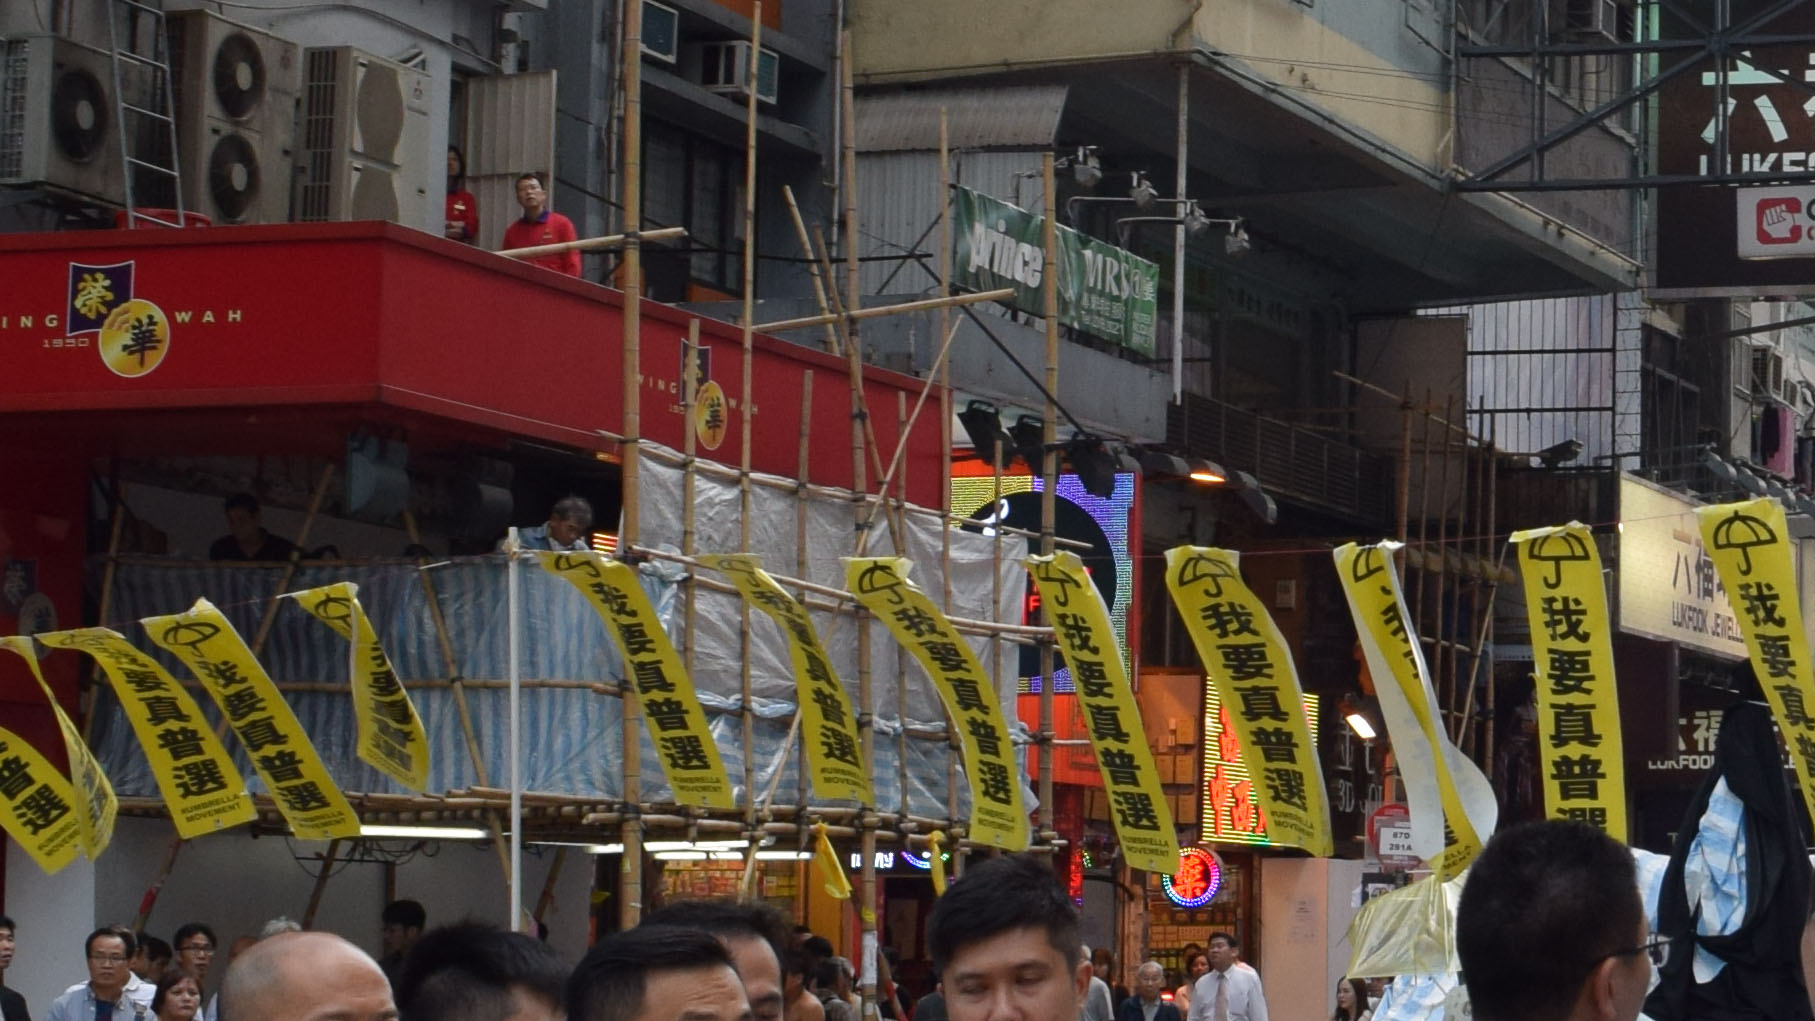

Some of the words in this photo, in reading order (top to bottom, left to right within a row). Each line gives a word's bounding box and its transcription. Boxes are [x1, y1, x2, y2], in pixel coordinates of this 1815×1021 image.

[74, 272, 115, 320] 榮
[969, 218, 1044, 288] prince
[121, 313, 163, 369] 華
[175, 309, 242, 324] WAH
[590, 582, 711, 772] 我要真普選
[895, 602, 1014, 807] 我要真普選
[1055, 612, 1161, 833] 我要真普選
[1199, 602, 1310, 813] 我要真普選
[196, 659, 330, 814] 我要真普選
[185, 802, 242, 823] MOVEMENT
